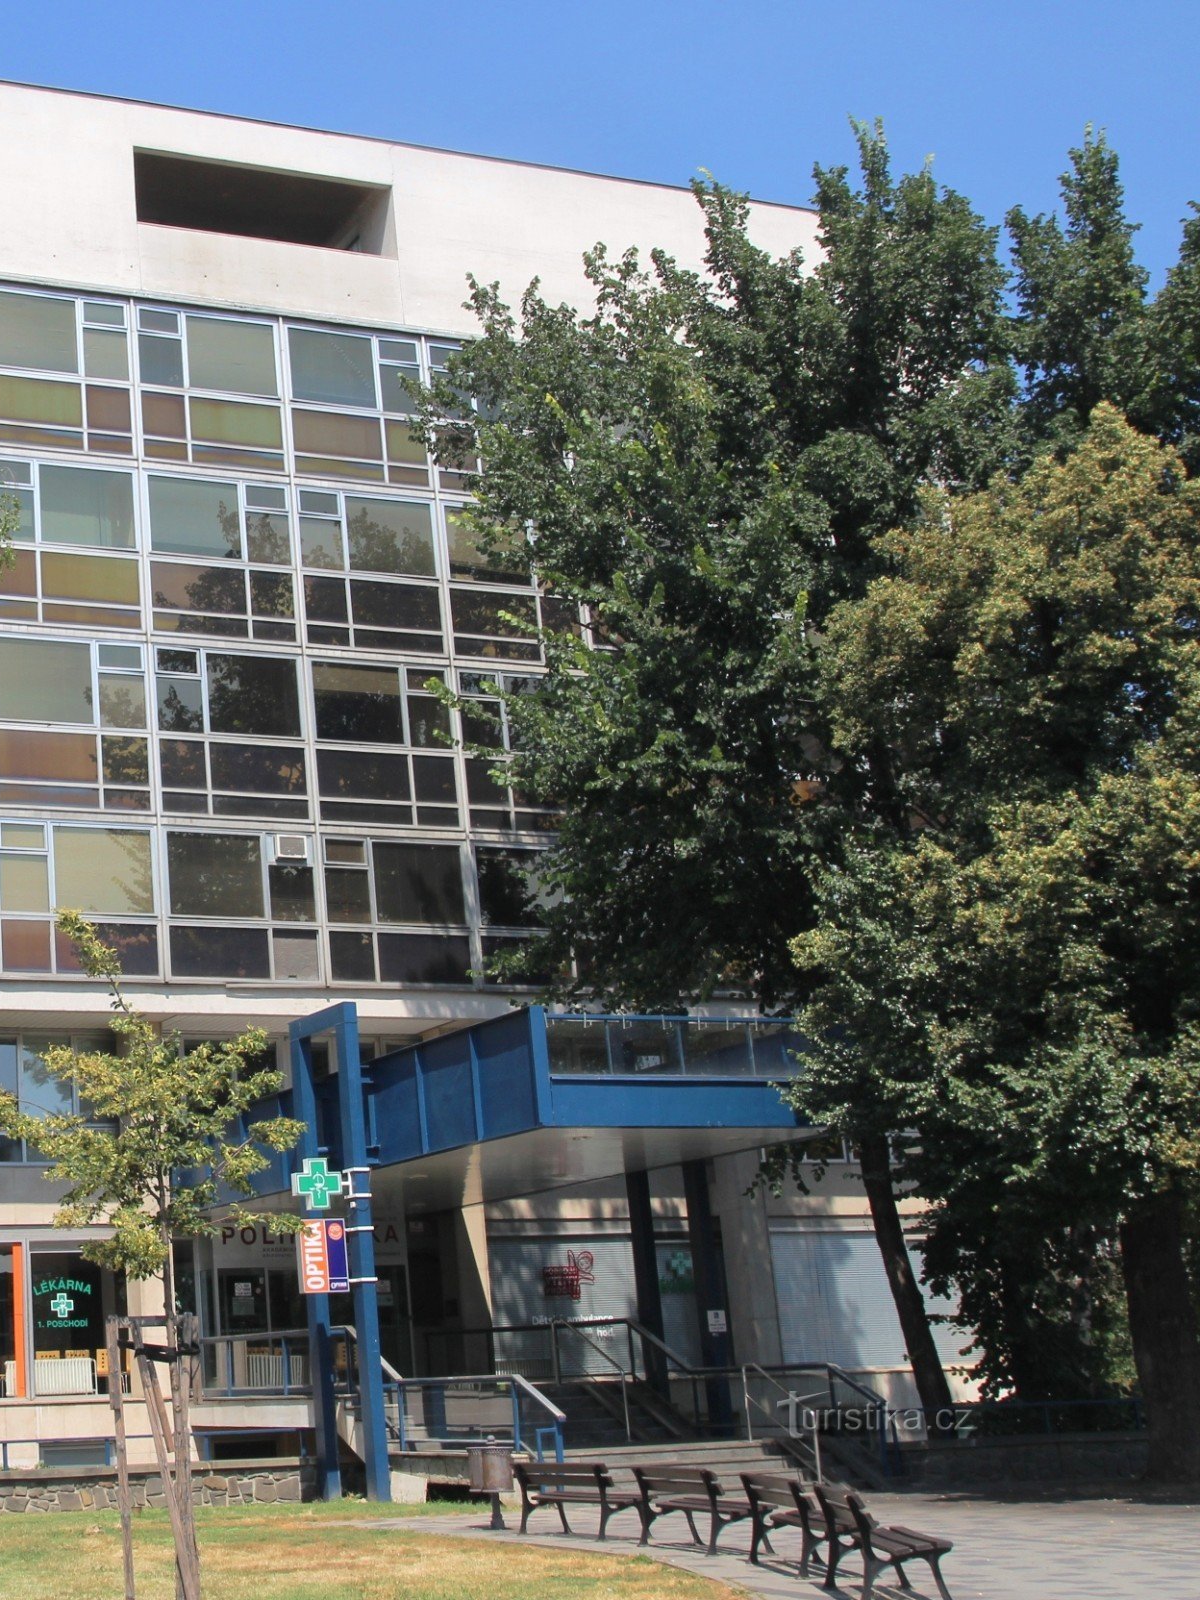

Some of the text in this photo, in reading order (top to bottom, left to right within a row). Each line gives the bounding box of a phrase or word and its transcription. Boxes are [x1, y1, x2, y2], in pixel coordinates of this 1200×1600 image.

[303, 1221, 325, 1290] OPTIKA
[33, 1277, 92, 1296] LÉKÁRNA
[46, 1318, 88, 1328] POSCHODÍ
